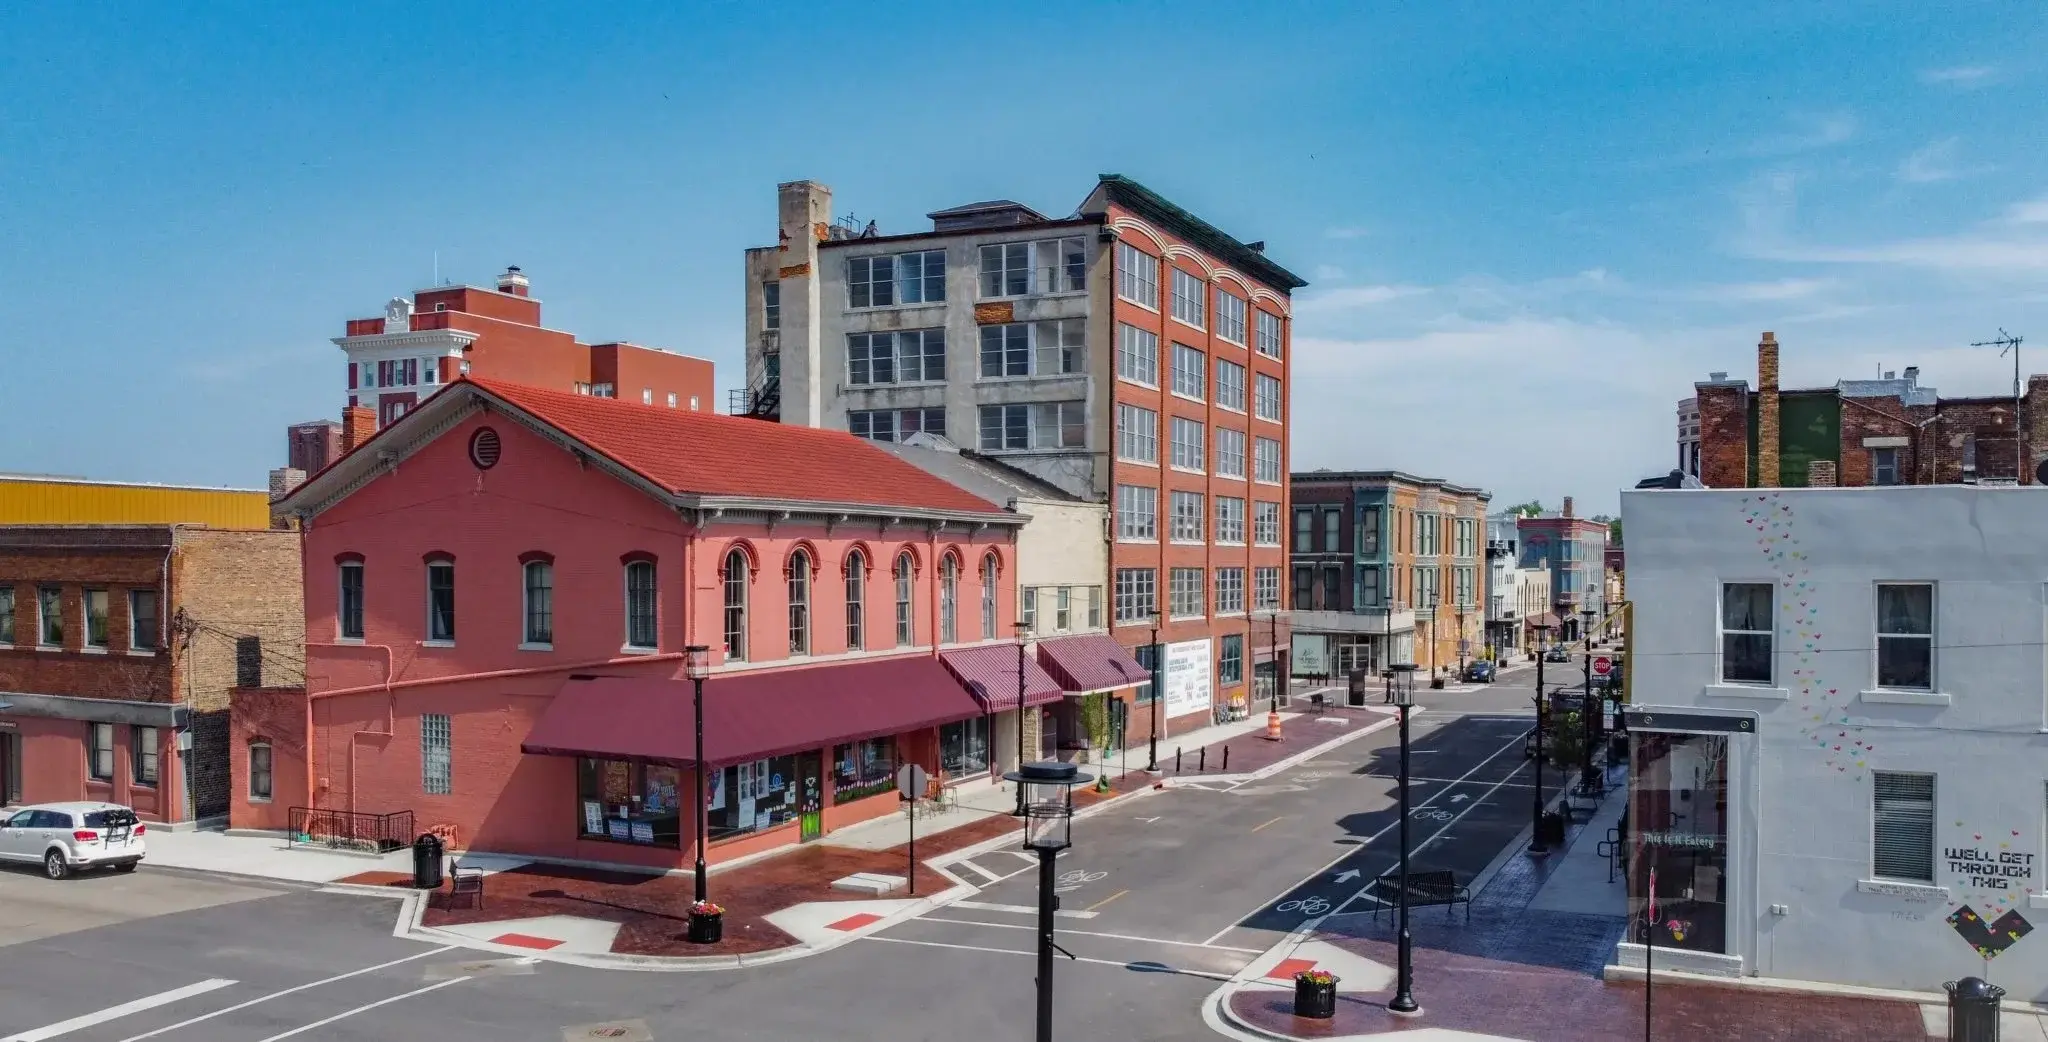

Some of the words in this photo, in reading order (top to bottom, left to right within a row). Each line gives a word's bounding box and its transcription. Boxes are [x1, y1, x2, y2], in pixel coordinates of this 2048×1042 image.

[1643, 833, 1661, 845] This
[1685, 835, 1714, 849] Eatery
[1999, 851, 2034, 864] GET
[1948, 861, 2031, 878] THROUGH
[1969, 876, 2008, 889] THIS
